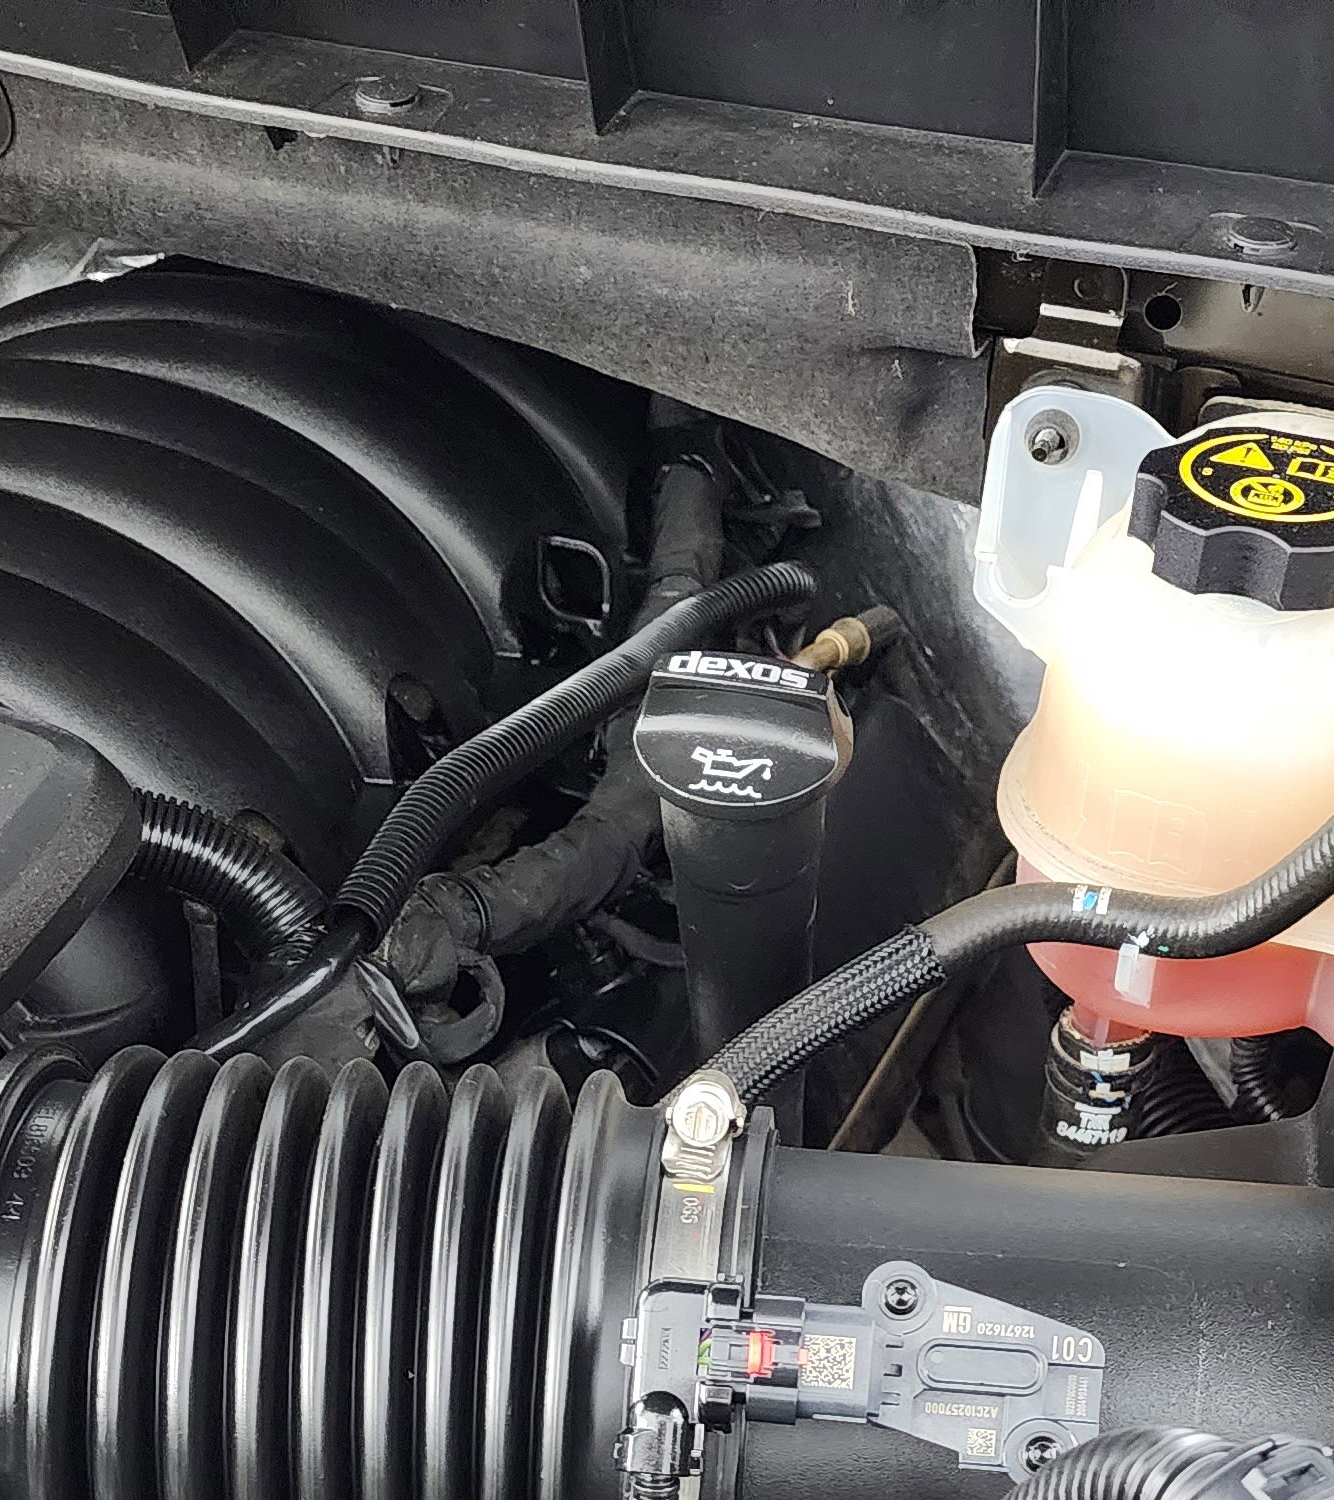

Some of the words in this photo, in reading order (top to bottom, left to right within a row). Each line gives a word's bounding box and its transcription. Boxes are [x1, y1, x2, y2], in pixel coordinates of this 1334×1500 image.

[668, 651, 809, 688] dexos
[942, 1311, 970, 1332] GM
[977, 1322, 1034, 1338] 12671620
[1051, 1335, 1092, 1361] C01
[924, 1401, 998, 1418] A2C10257000
